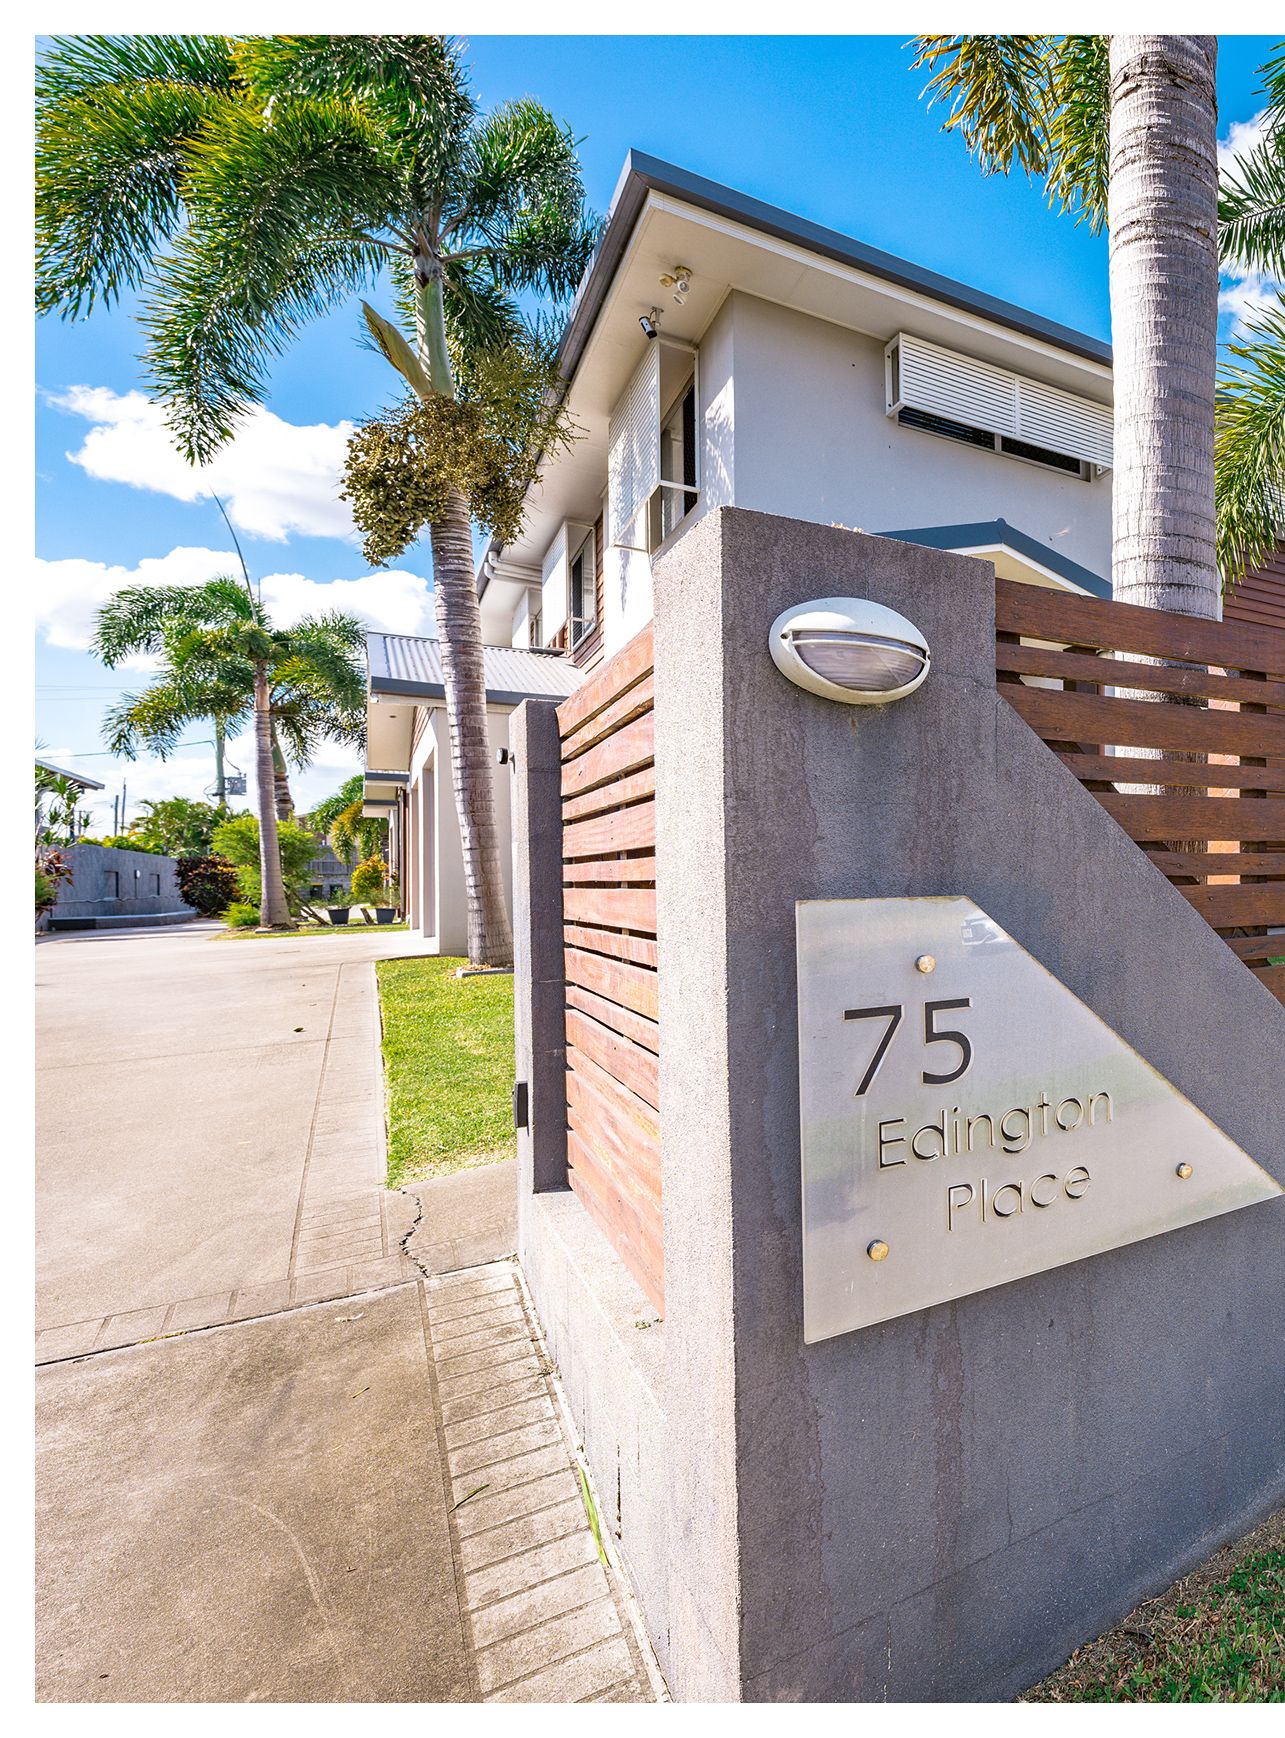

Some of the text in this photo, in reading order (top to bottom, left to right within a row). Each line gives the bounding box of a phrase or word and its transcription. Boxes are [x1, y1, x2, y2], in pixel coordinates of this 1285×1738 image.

[843, 997, 975, 1097] 75
[877, 1091, 1114, 1171] Edington
[947, 1165, 1092, 1232] Place
